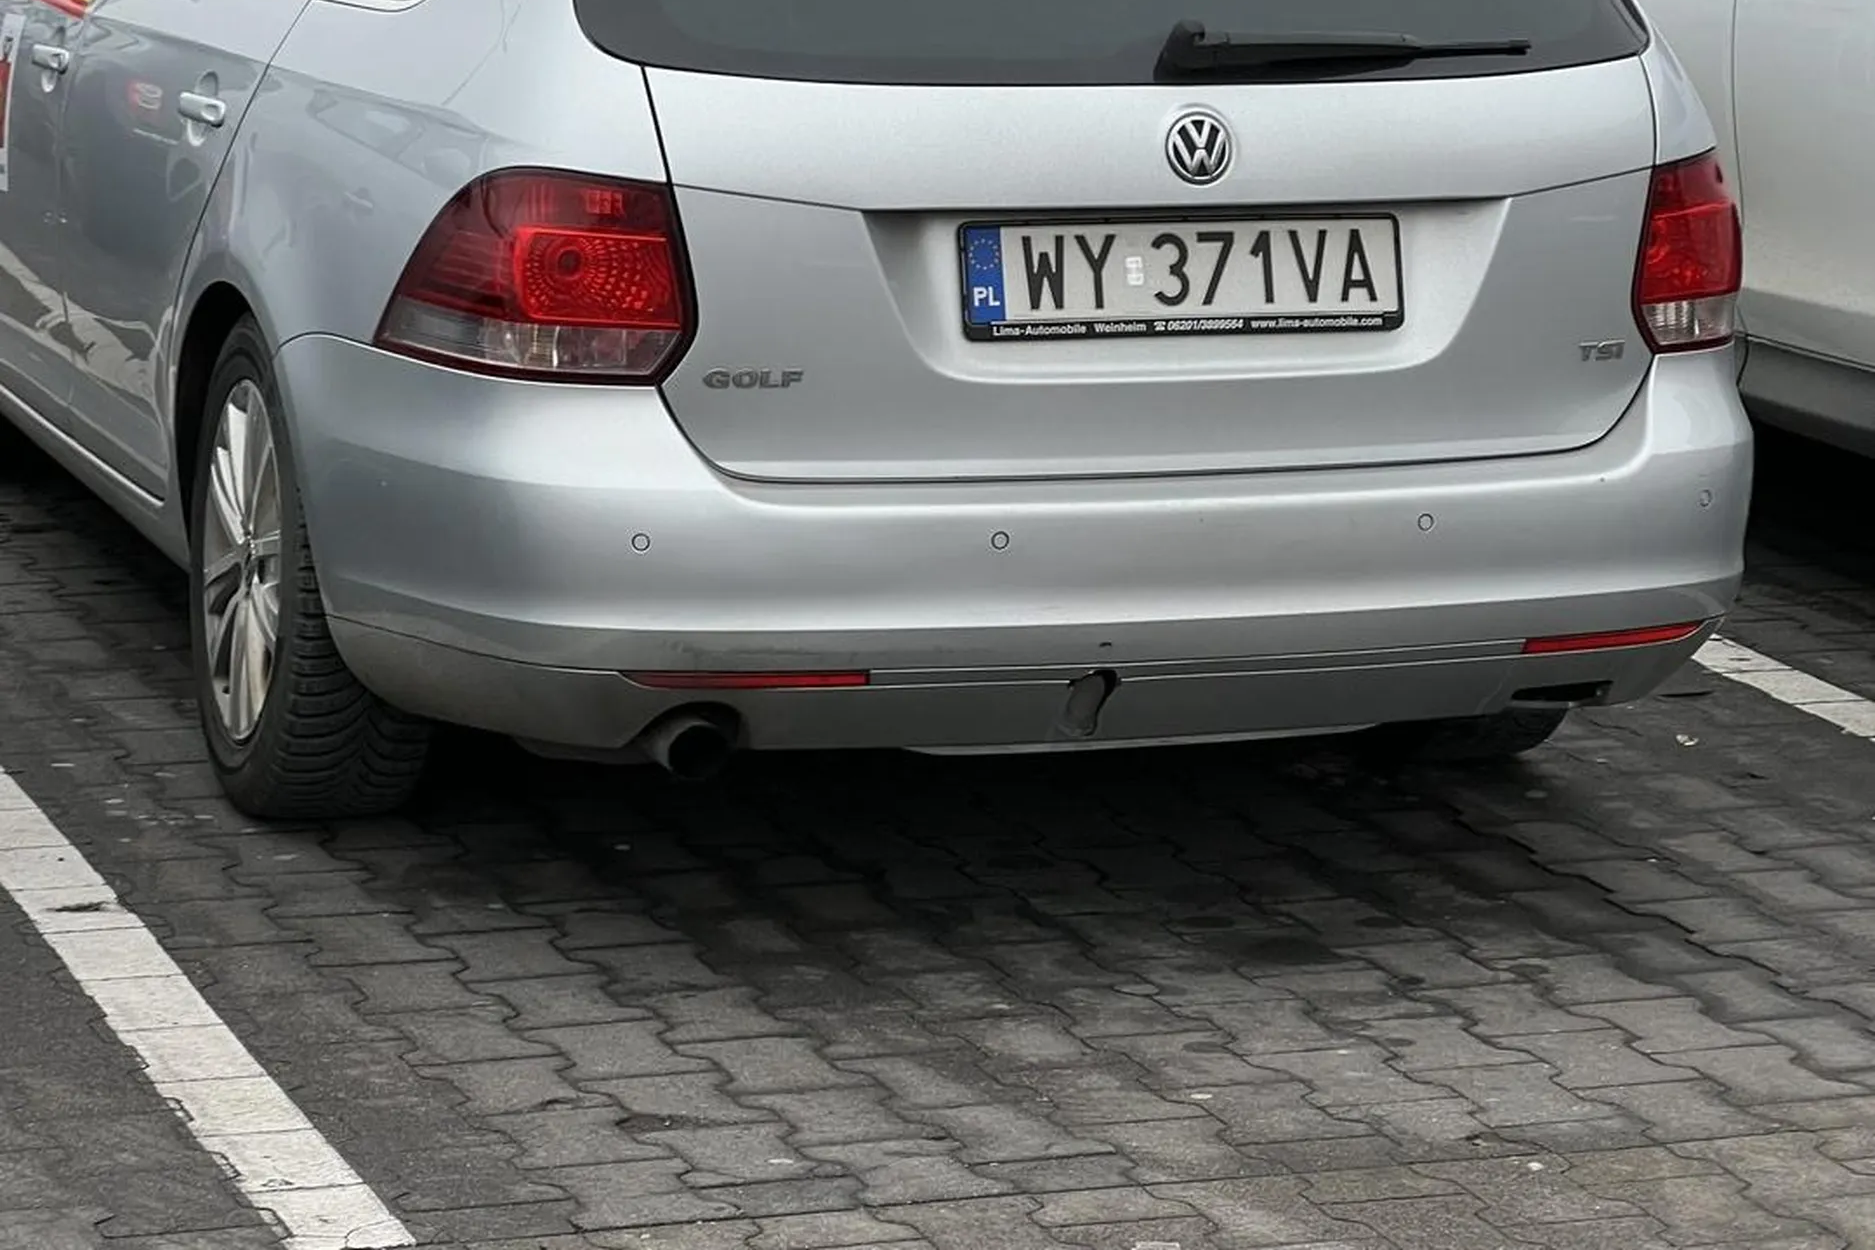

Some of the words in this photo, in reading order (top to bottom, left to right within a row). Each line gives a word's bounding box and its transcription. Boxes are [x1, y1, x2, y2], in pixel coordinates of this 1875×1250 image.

[1022, 234, 1116, 310] WY
[1151, 229, 1378, 306] 371VA
[973, 286, 1000, 307] PL
[993, 324, 1086, 336] Lima-Automobile
[1094, 322, 1147, 333] Weinheim
[1579, 340, 1625, 361] TSI
[702, 368, 804, 389] GOLF
